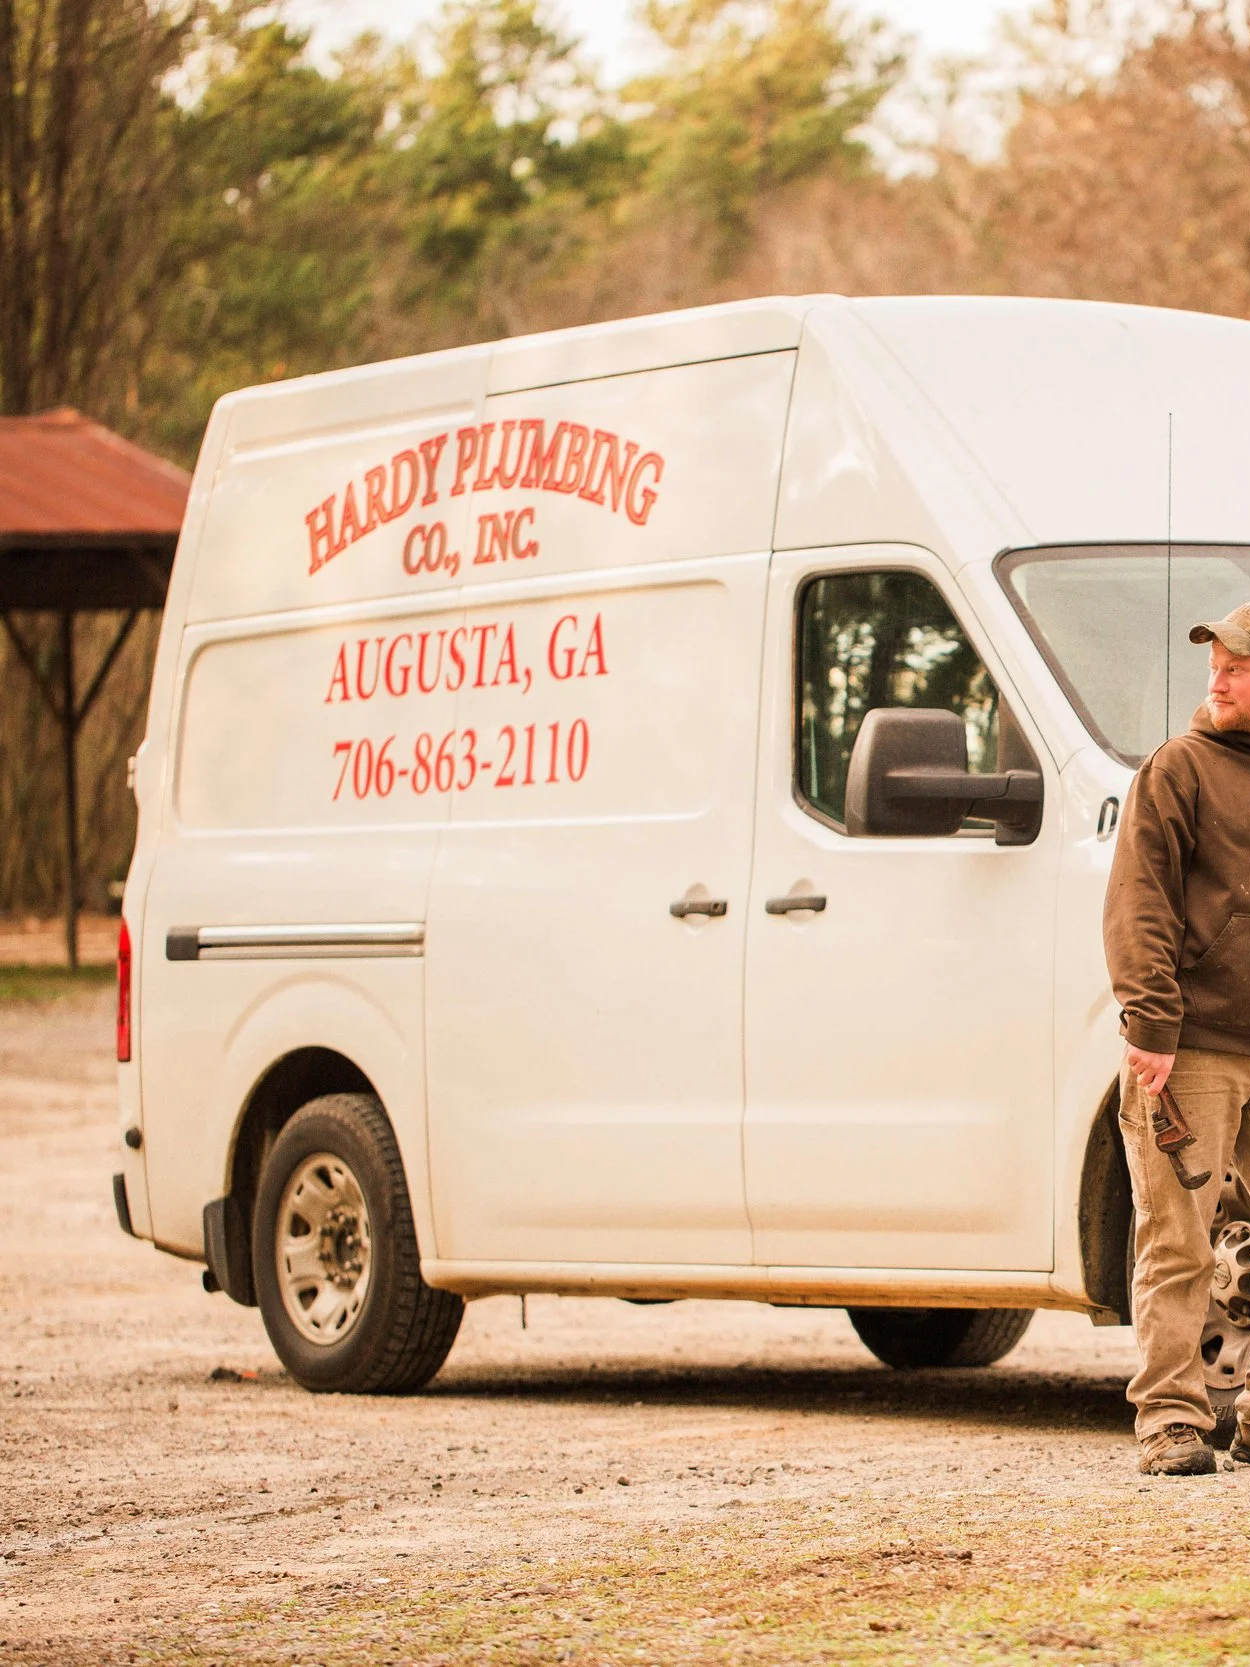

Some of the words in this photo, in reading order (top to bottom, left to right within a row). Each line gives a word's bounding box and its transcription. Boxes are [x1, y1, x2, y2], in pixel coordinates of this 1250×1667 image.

[304, 433, 449, 576] HARDY
[451, 418, 665, 526] PLUMBING
[403, 521, 462, 578] CO.,
[473, 506, 541, 567] INC.
[324, 621, 533, 704] AUGUSTA,
[546, 612, 609, 684] GA
[331, 717, 590, 802] 706-863-2110
